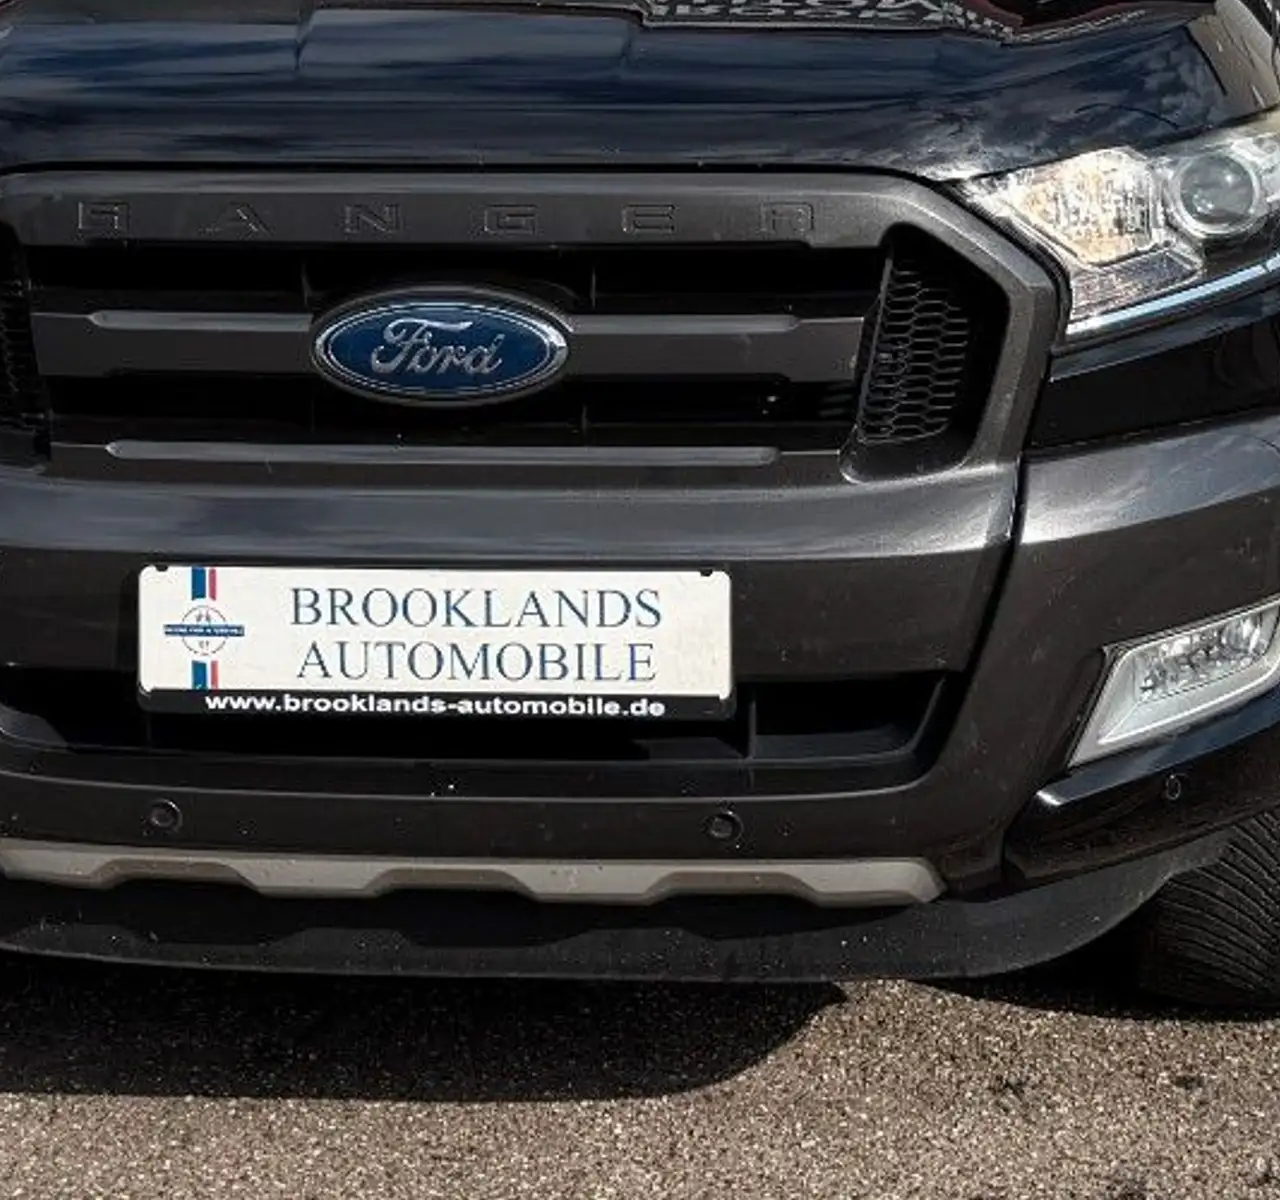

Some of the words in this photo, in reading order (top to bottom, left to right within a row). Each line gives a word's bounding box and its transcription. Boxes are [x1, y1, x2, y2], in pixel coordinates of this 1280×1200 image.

[75, 202, 817, 234] RANGER
[371, 317, 506, 374] Ford
[289, 587, 663, 630] BROOKLANDS
[296, 641, 658, 682] AUTOMOBILE
[205, 693, 666, 717] www.brooklands-automobile.de
